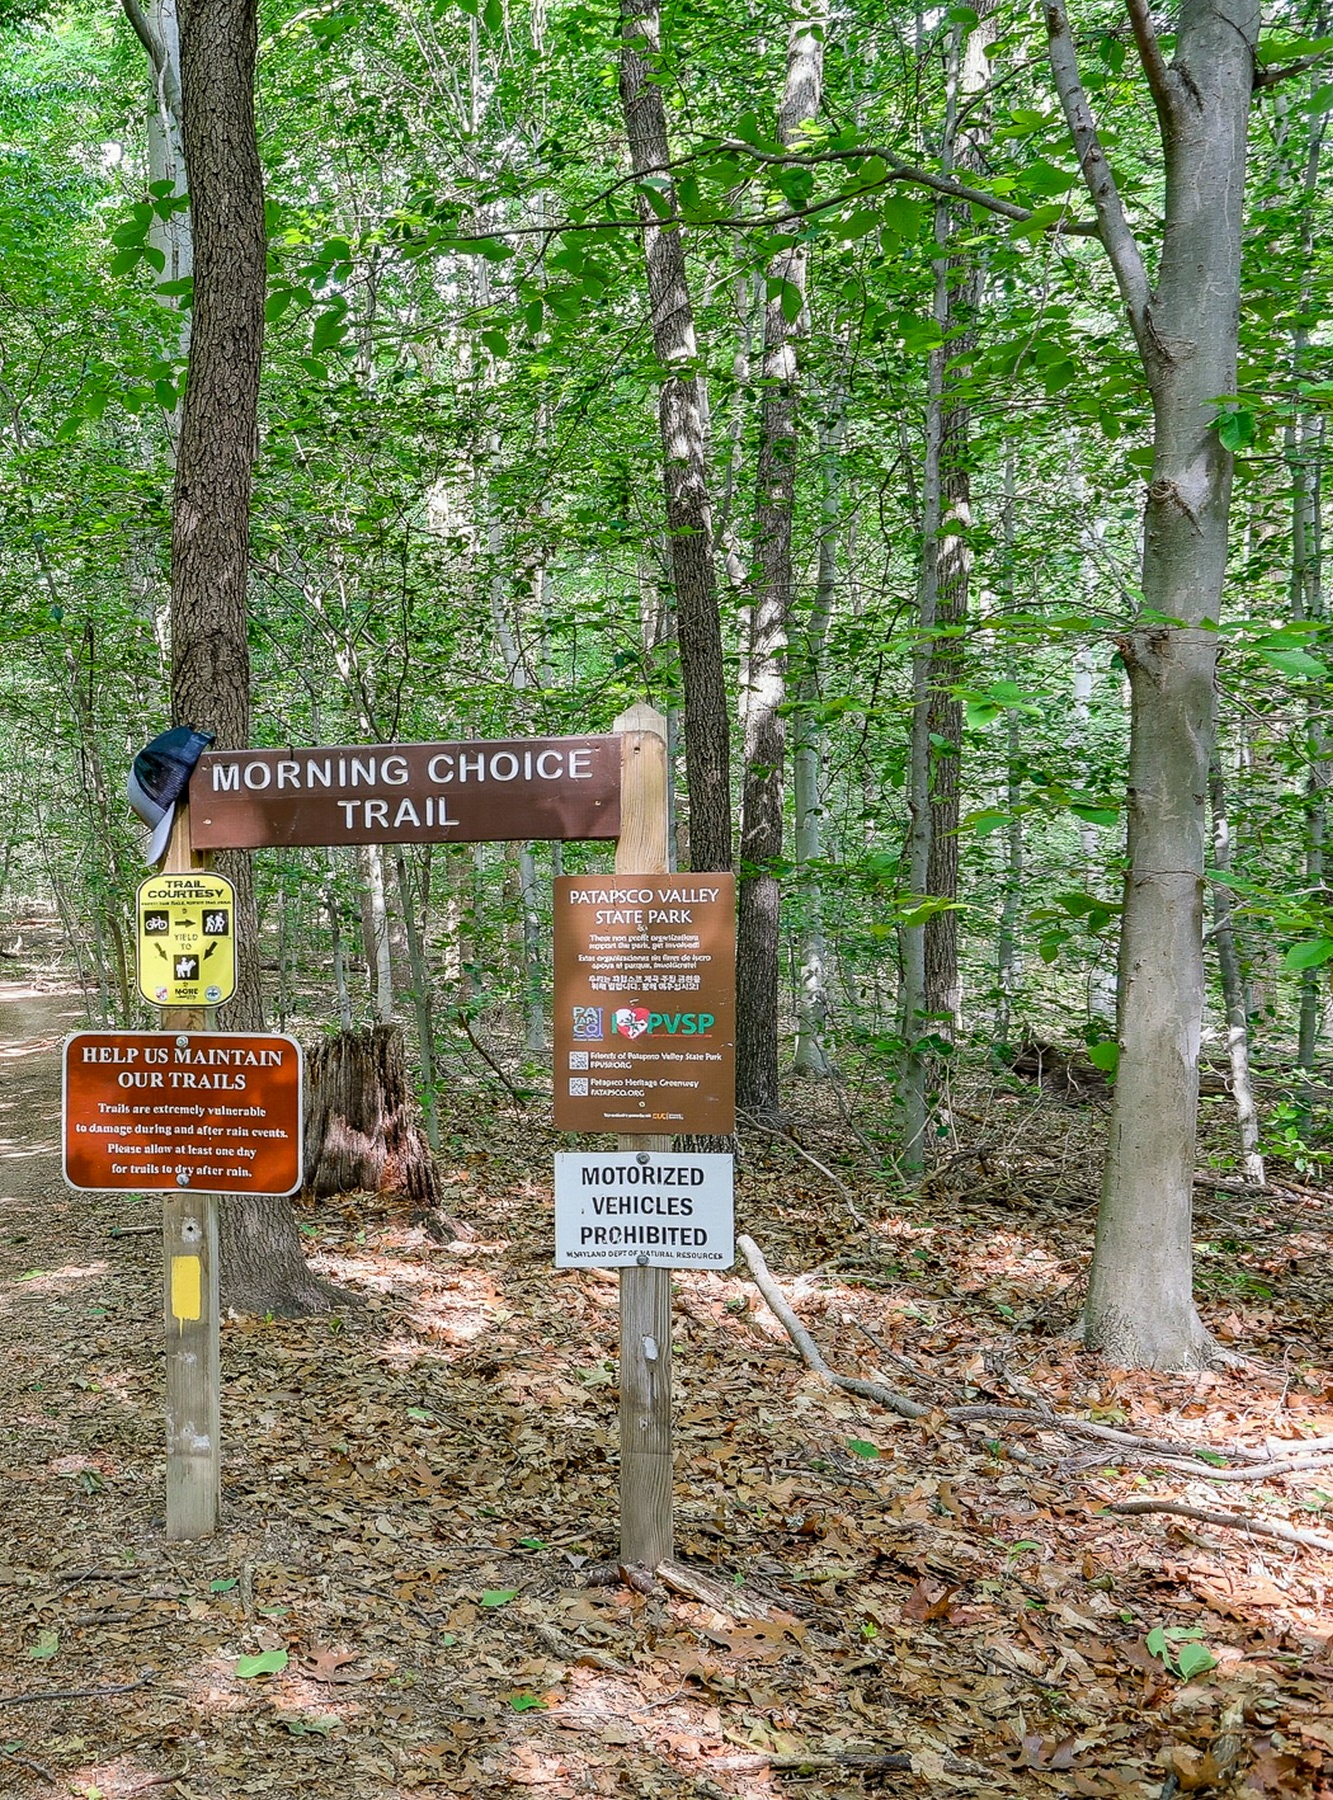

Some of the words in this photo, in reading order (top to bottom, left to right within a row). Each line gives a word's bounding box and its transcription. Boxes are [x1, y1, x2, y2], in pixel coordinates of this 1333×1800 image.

[212, 753, 409, 792] MORNING
[428, 748, 593, 784] CHOICE
[337, 797, 460, 829] TRAIL
[165, 880, 206, 888] TRAIL
[148, 889, 224, 898] COURTESY
[570, 889, 653, 904] PATAPSCO
[658, 888, 719, 903] VALLEY
[596, 909, 643, 925] STATE
[648, 909, 693, 924] PARK
[647, 1013, 715, 1035] PVSP
[82, 1047, 139, 1064] HELP
[144, 1048, 169, 1065] US
[174, 1049, 283, 1066] MAINTAIN
[590, 1052, 616, 1061] Friends
[617, 1052, 627, 1060] of
[661, 1052, 684, 1062] Valley
[685, 1053, 704, 1061] State
[706, 1053, 722, 1061] Park
[118, 1072, 164, 1088] OUR
[169, 1073, 246, 1090] TRAILS
[590, 1078, 624, 1087] Patapsco
[625, 1079, 657, 1088] Heritage
[659, 1079, 699, 1089] Greenway
[98, 1103, 130, 1114] Trails
[133, 1105, 150, 1114] are
[153, 1104, 205, 1117] extremely
[208, 1105, 266, 1117] vulnerable
[76, 1124, 87, 1133] to
[89, 1124, 132, 1136] damage
[134, 1124, 172, 1136] during
[174, 1125, 194, 1135] and
[197, 1126, 223, 1136] after
[226, 1127, 249, 1137] rain
[252, 1128, 288, 1138] events.
[108, 1143, 141, 1154] Please
[144, 1144, 173, 1154] allow
[175, 1146, 186, 1155] at
[188, 1145, 212, 1155] least
[216, 1147, 234, 1156] one
[237, 1146, 257, 1159] day
[111, 1164, 128, 1174] for
[130, 1164, 160, 1174] trails
[162, 1165, 173, 1174] to
[175, 1165, 194, 1177] dry
[197, 1166, 223, 1176] after
[226, 1166, 252, 1177] rain.
[581, 1166, 704, 1186] MOTORIZED
[592, 1196, 693, 1216] VEHICLES
[581, 1226, 708, 1246] PROHIBITED
[566, 1250, 607, 1258] MARYLAND
[676, 1251, 723, 1260] RESOURCES
